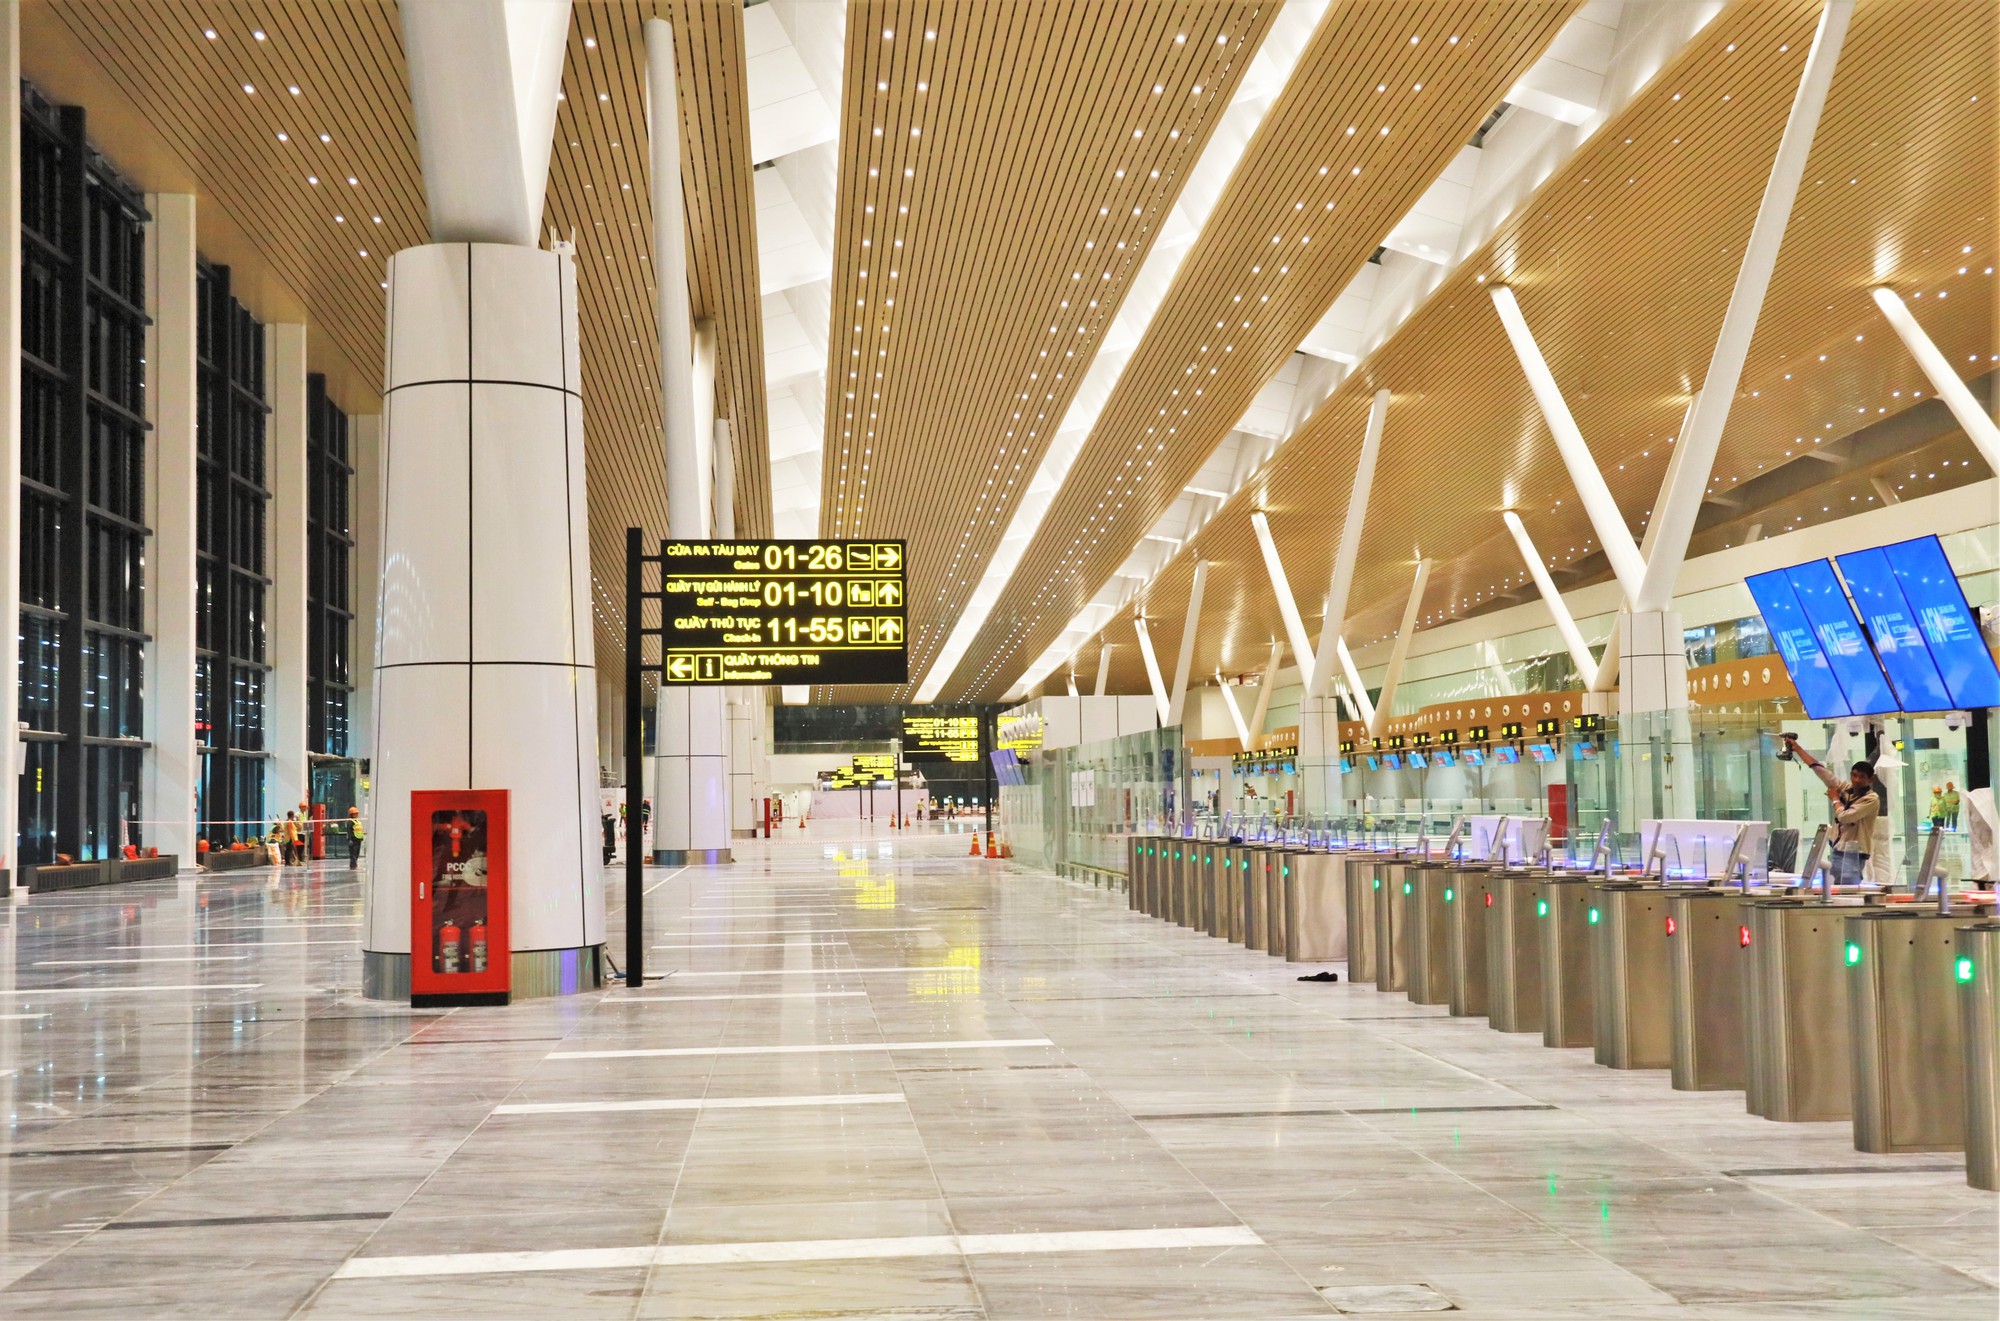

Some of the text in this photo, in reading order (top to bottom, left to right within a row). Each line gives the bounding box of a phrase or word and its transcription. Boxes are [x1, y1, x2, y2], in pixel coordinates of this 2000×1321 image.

[693, 545, 710, 556] RA
[711, 543, 734, 556] TÀU
[736, 545, 760, 556] BAY
[764, 545, 843, 570] 01-26
[733, 560, 761, 570] Gates
[764, 581, 843, 607] 01-10
[696, 597, 714, 606] Self
[720, 597, 739, 608] Bag
[739, 597, 762, 608] Drop
[736, 617, 761, 631] TỤC
[767, 617, 844, 642] 11-55
[723, 633, 761, 643] Check-in
[758, 653, 799, 666] THÔNG
[800, 654, 820, 665] TIN
[724, 670, 772, 680] Information
